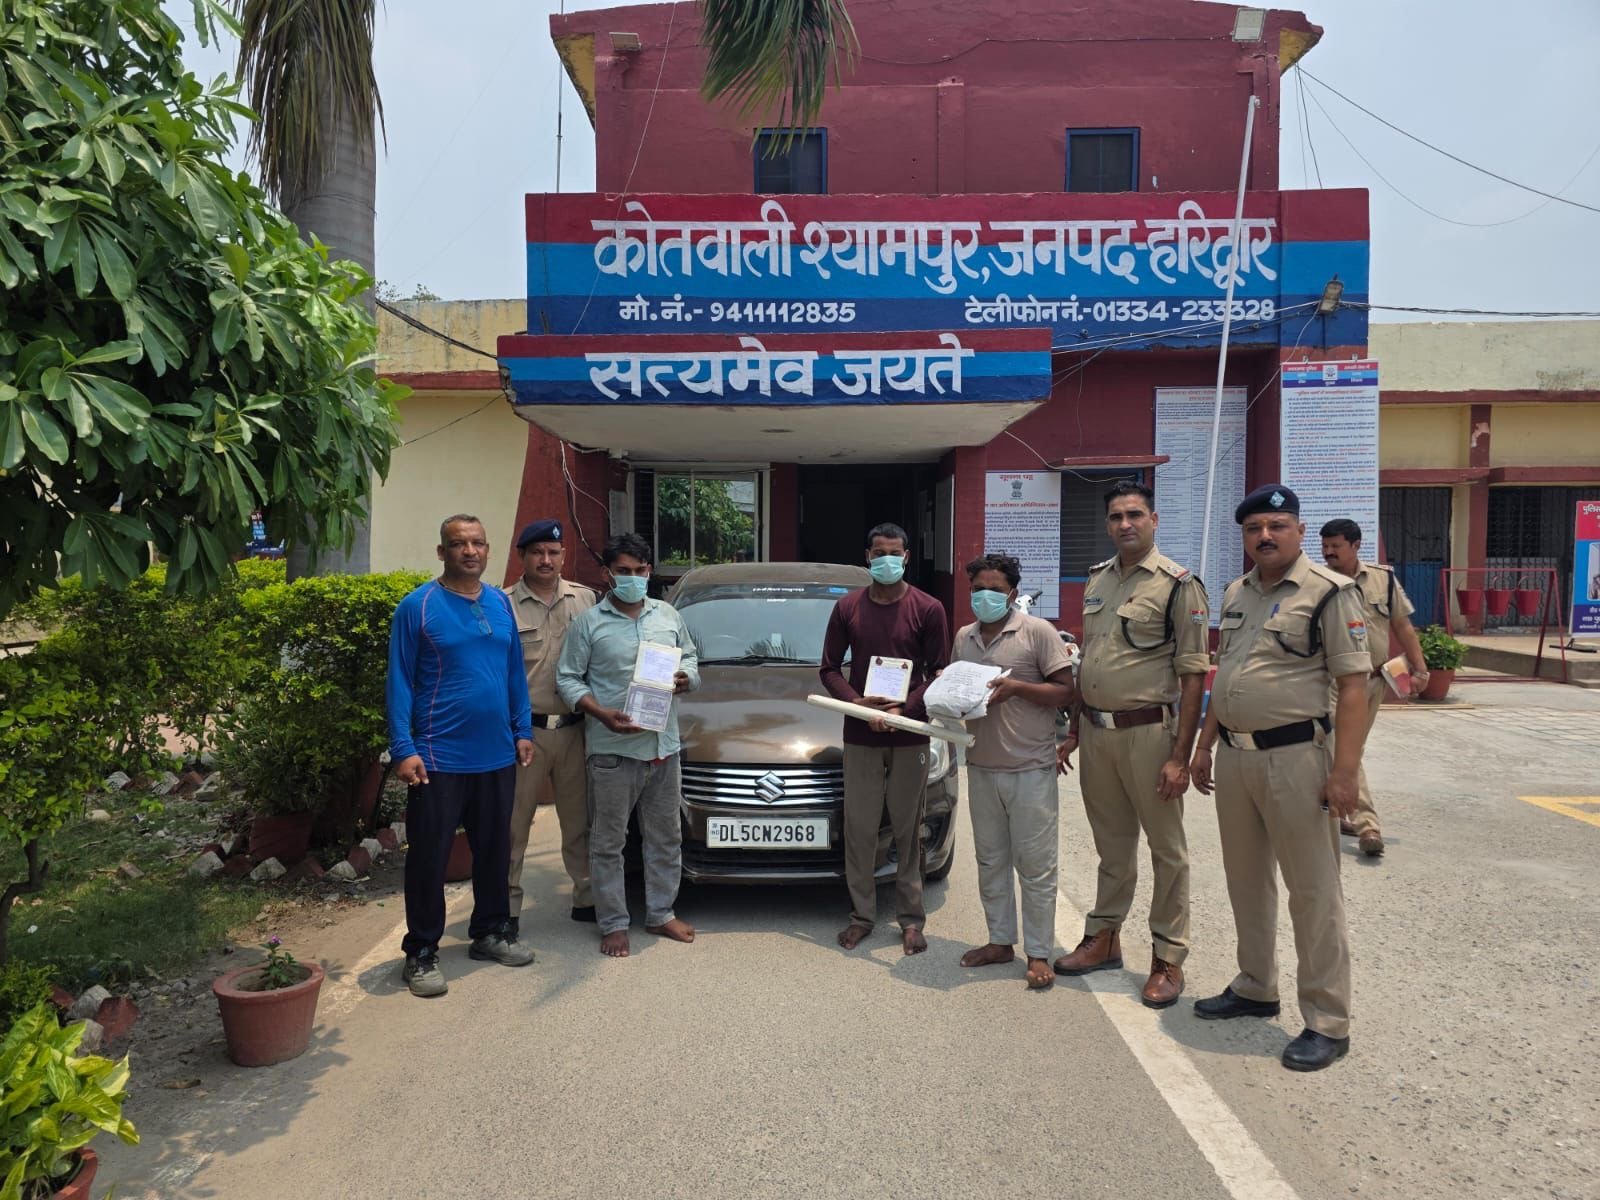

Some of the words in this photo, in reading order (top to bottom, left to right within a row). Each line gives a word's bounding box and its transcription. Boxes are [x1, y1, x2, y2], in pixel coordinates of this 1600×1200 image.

[591, 200, 796, 278] कोतवाली
[800, 220, 990, 294] श्यामपुर,
[710, 302, 856, 323] 9411112835
[965, 293, 1060, 323] टेलीफोन
[585, 336, 819, 400] सत्यमेव
[832, 333, 975, 396] जयते
[719, 824, 815, 842] DL5CN2968
